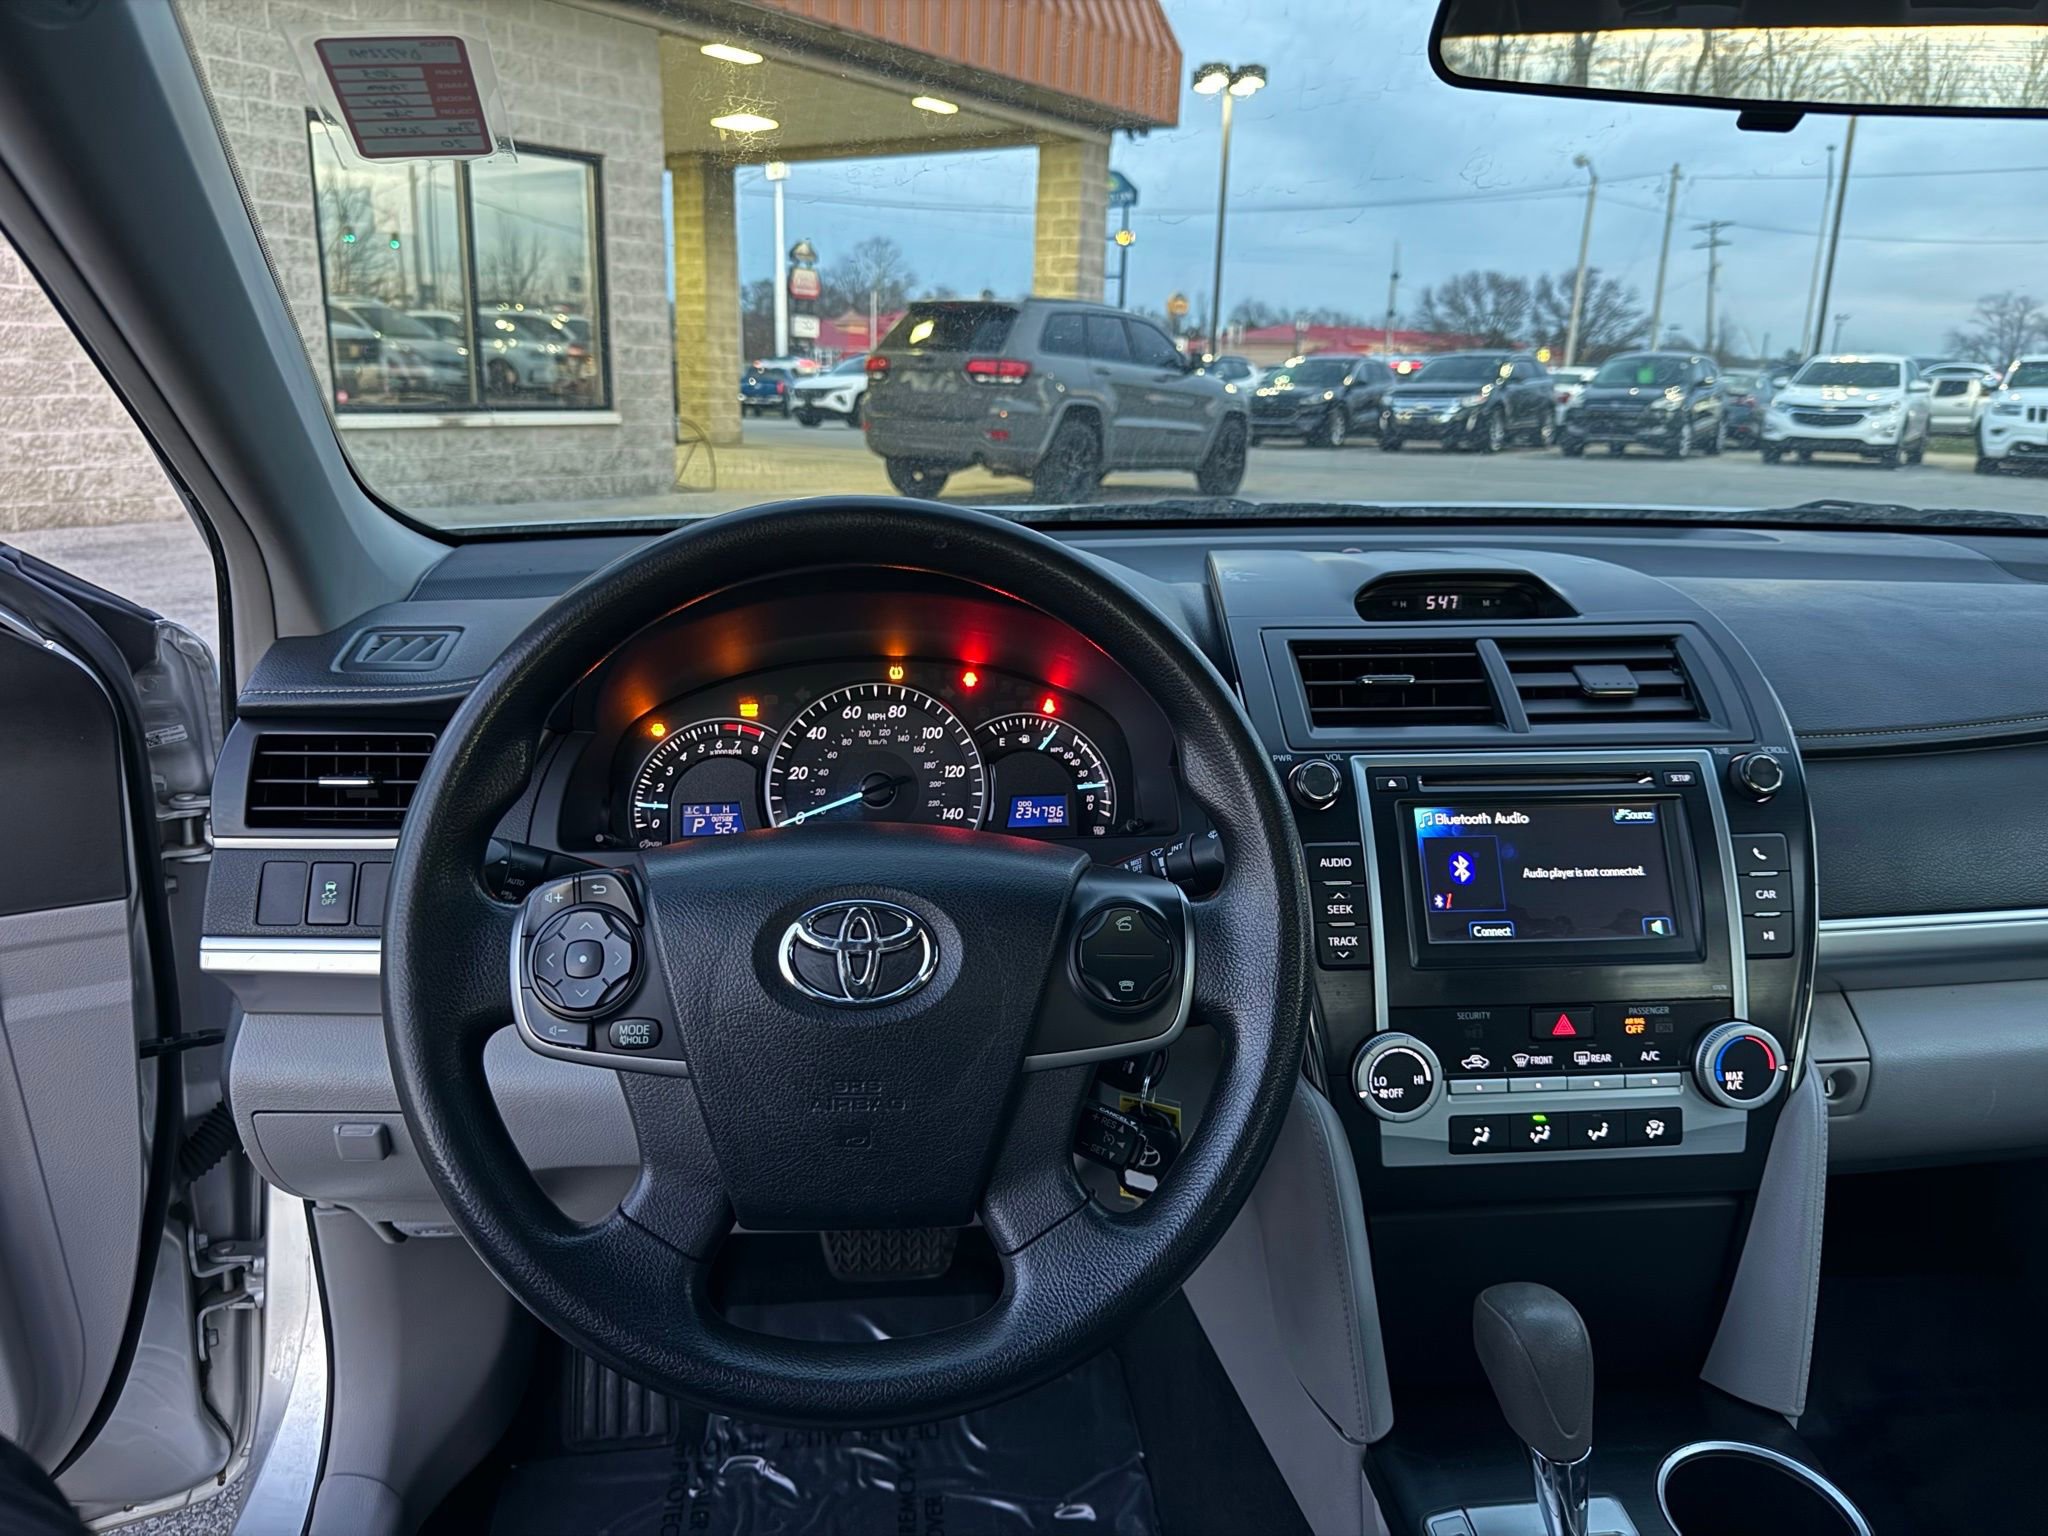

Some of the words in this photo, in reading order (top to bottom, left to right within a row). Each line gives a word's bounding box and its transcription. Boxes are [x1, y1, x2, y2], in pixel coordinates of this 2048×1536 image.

[842, 705, 862, 719] 60
[867, 713, 886, 721] MPH
[888, 705, 907, 719] 80
[806, 726, 827, 740] 40
[858, 730, 872, 738] 100
[878, 728, 891, 736] 120
[922, 727, 944, 740] 100
[841, 738, 853, 746] 80
[897, 734, 910, 742] 140
[999, 737, 1006, 747] E
[697, 743, 706, 754] 5
[715, 739, 723, 749] 6
[733, 740, 742, 750] 7
[913, 745, 926, 753] 160
[751, 745, 759, 755] 8
[1761, 746, 1790, 755] SCROLL
[679, 752, 687, 761] 4
[827, 751, 838, 760] 60
[1063, 751, 1074, 760] 60
[1272, 754, 1293, 763] PWR
[1325, 753, 1344, 761] VOL
[1069, 758, 1081, 767] 40
[665, 766, 674, 776] 3
[787, 766, 809, 780] 20
[817, 768, 829, 776] 40
[944, 765, 965, 778] 120
[1077, 769, 1088, 778] 30
[1670, 774, 1691, 782] SETUP
[656, 783, 665, 793] 2
[928, 780, 942, 788] 200
[814, 787, 827, 796] 20
[1085, 795, 1095, 803] 10
[692, 805, 701, 814] C
[722, 804, 730, 813] H
[1087, 803, 1094, 811] 0
[942, 808, 964, 820] 140
[1015, 806, 1064, 819] 234796
[1624, 809, 1654, 821] Source
[711, 815, 734, 823] OUTSIDE
[1435, 811, 1492, 825] Bluetooth
[1494, 811, 1531, 825] Audio
[652, 819, 660, 829] 0
[692, 818, 706, 833] P
[1319, 857, 1352, 868] AUDIO
[1522, 867, 1549, 879] Audio
[1550, 867, 1575, 881] player
[1575, 867, 1583, 878] is
[1583, 867, 1599, 878] not
[507, 878, 525, 887] AUTO
[1755, 889, 1776, 899] CAR
[321, 898, 337, 906] OFF
[1326, 904, 1353, 915] SEEK
[1473, 924, 1513, 938] Connect
[1328, 936, 1359, 947] TRACK
[1628, 1006, 1670, 1015] PASSENGER
[1456, 1011, 1491, 1021] SECURITY
[619, 1024, 650, 1035] MODE
[1625, 1024, 1645, 1034] OFF
[626, 1035, 649, 1045] HOLD
[1530, 1055, 1553, 1065] FRONT
[1591, 1053, 1612, 1063] REAR
[1640, 1051, 1660, 1062] A/C
[1413, 1075, 1425, 1085] HI
[1725, 1071, 1744, 1081] MAX
[1374, 1076, 1388, 1087] LO
[1726, 1080, 1743, 1090] A/C
[1388, 1088, 1404, 1099] OFF
[1101, 1116, 1118, 1129] RES
[1090, 1143, 1108, 1156] SET
